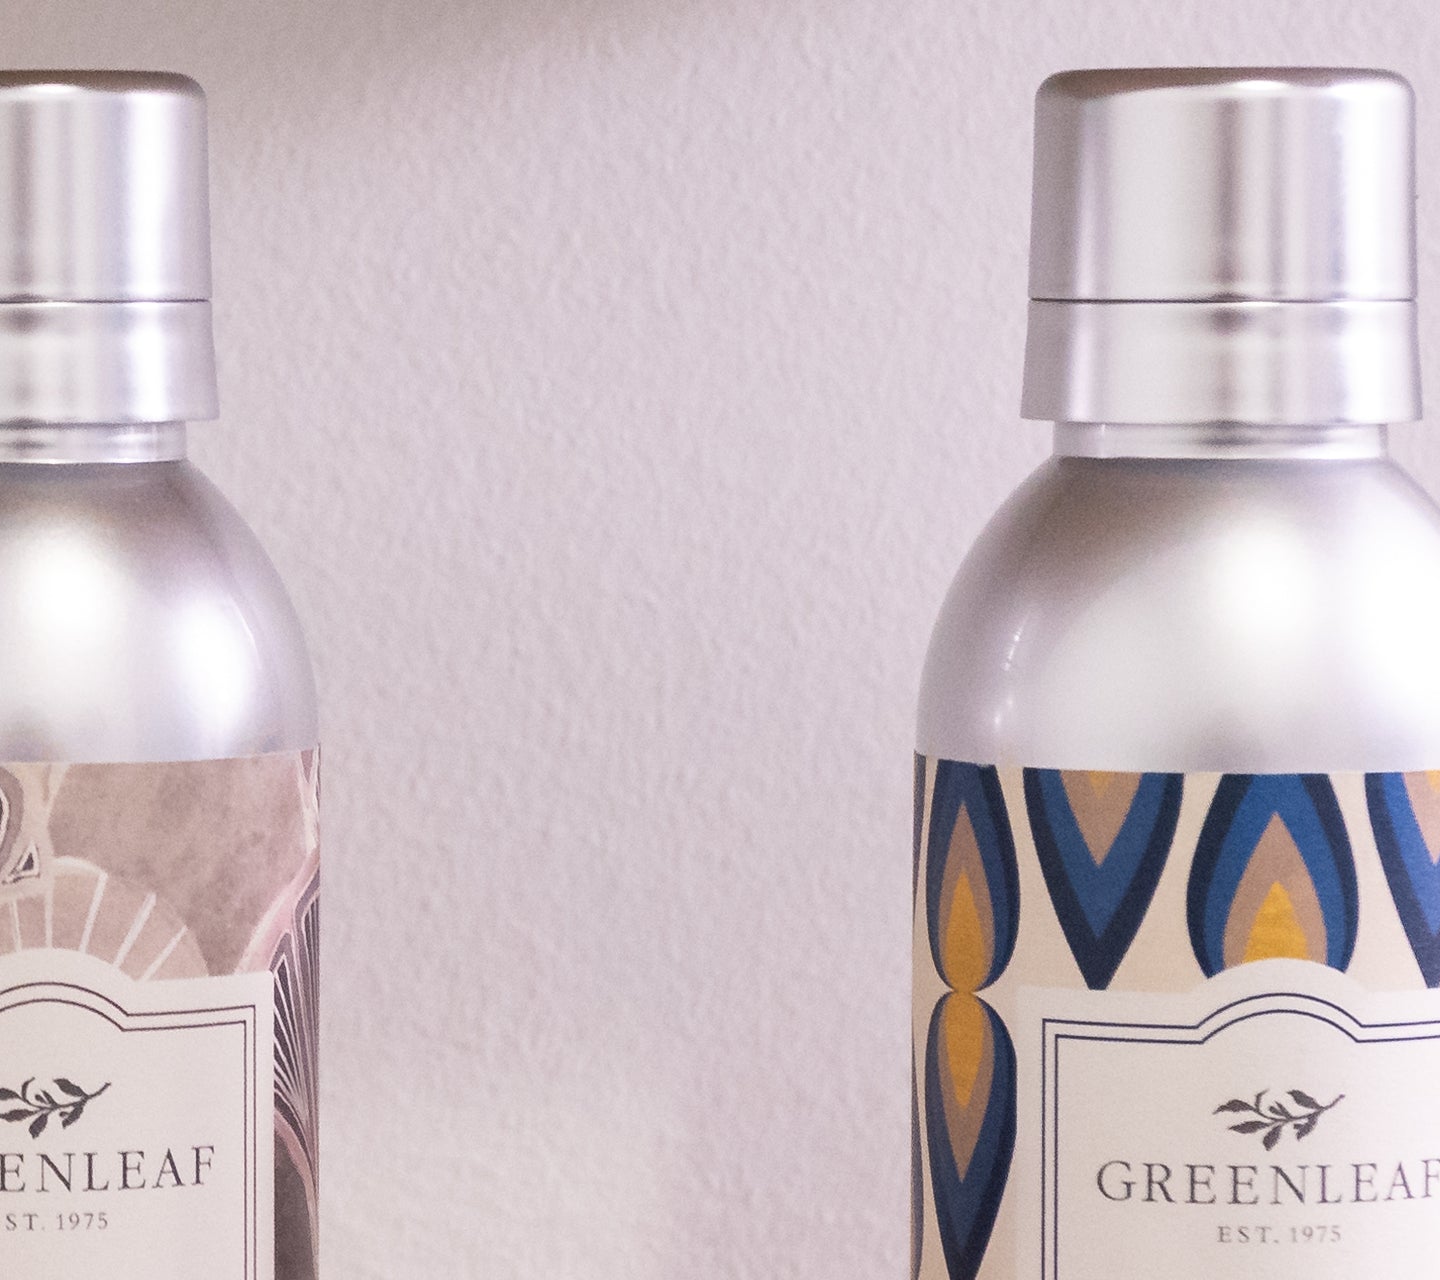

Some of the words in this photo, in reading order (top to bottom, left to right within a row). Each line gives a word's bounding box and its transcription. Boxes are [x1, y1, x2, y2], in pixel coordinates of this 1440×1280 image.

[57, 1211, 109, 1231] 1975
[1217, 1225, 1279, 1244] EST.
[1288, 1224, 1341, 1244] 1975
